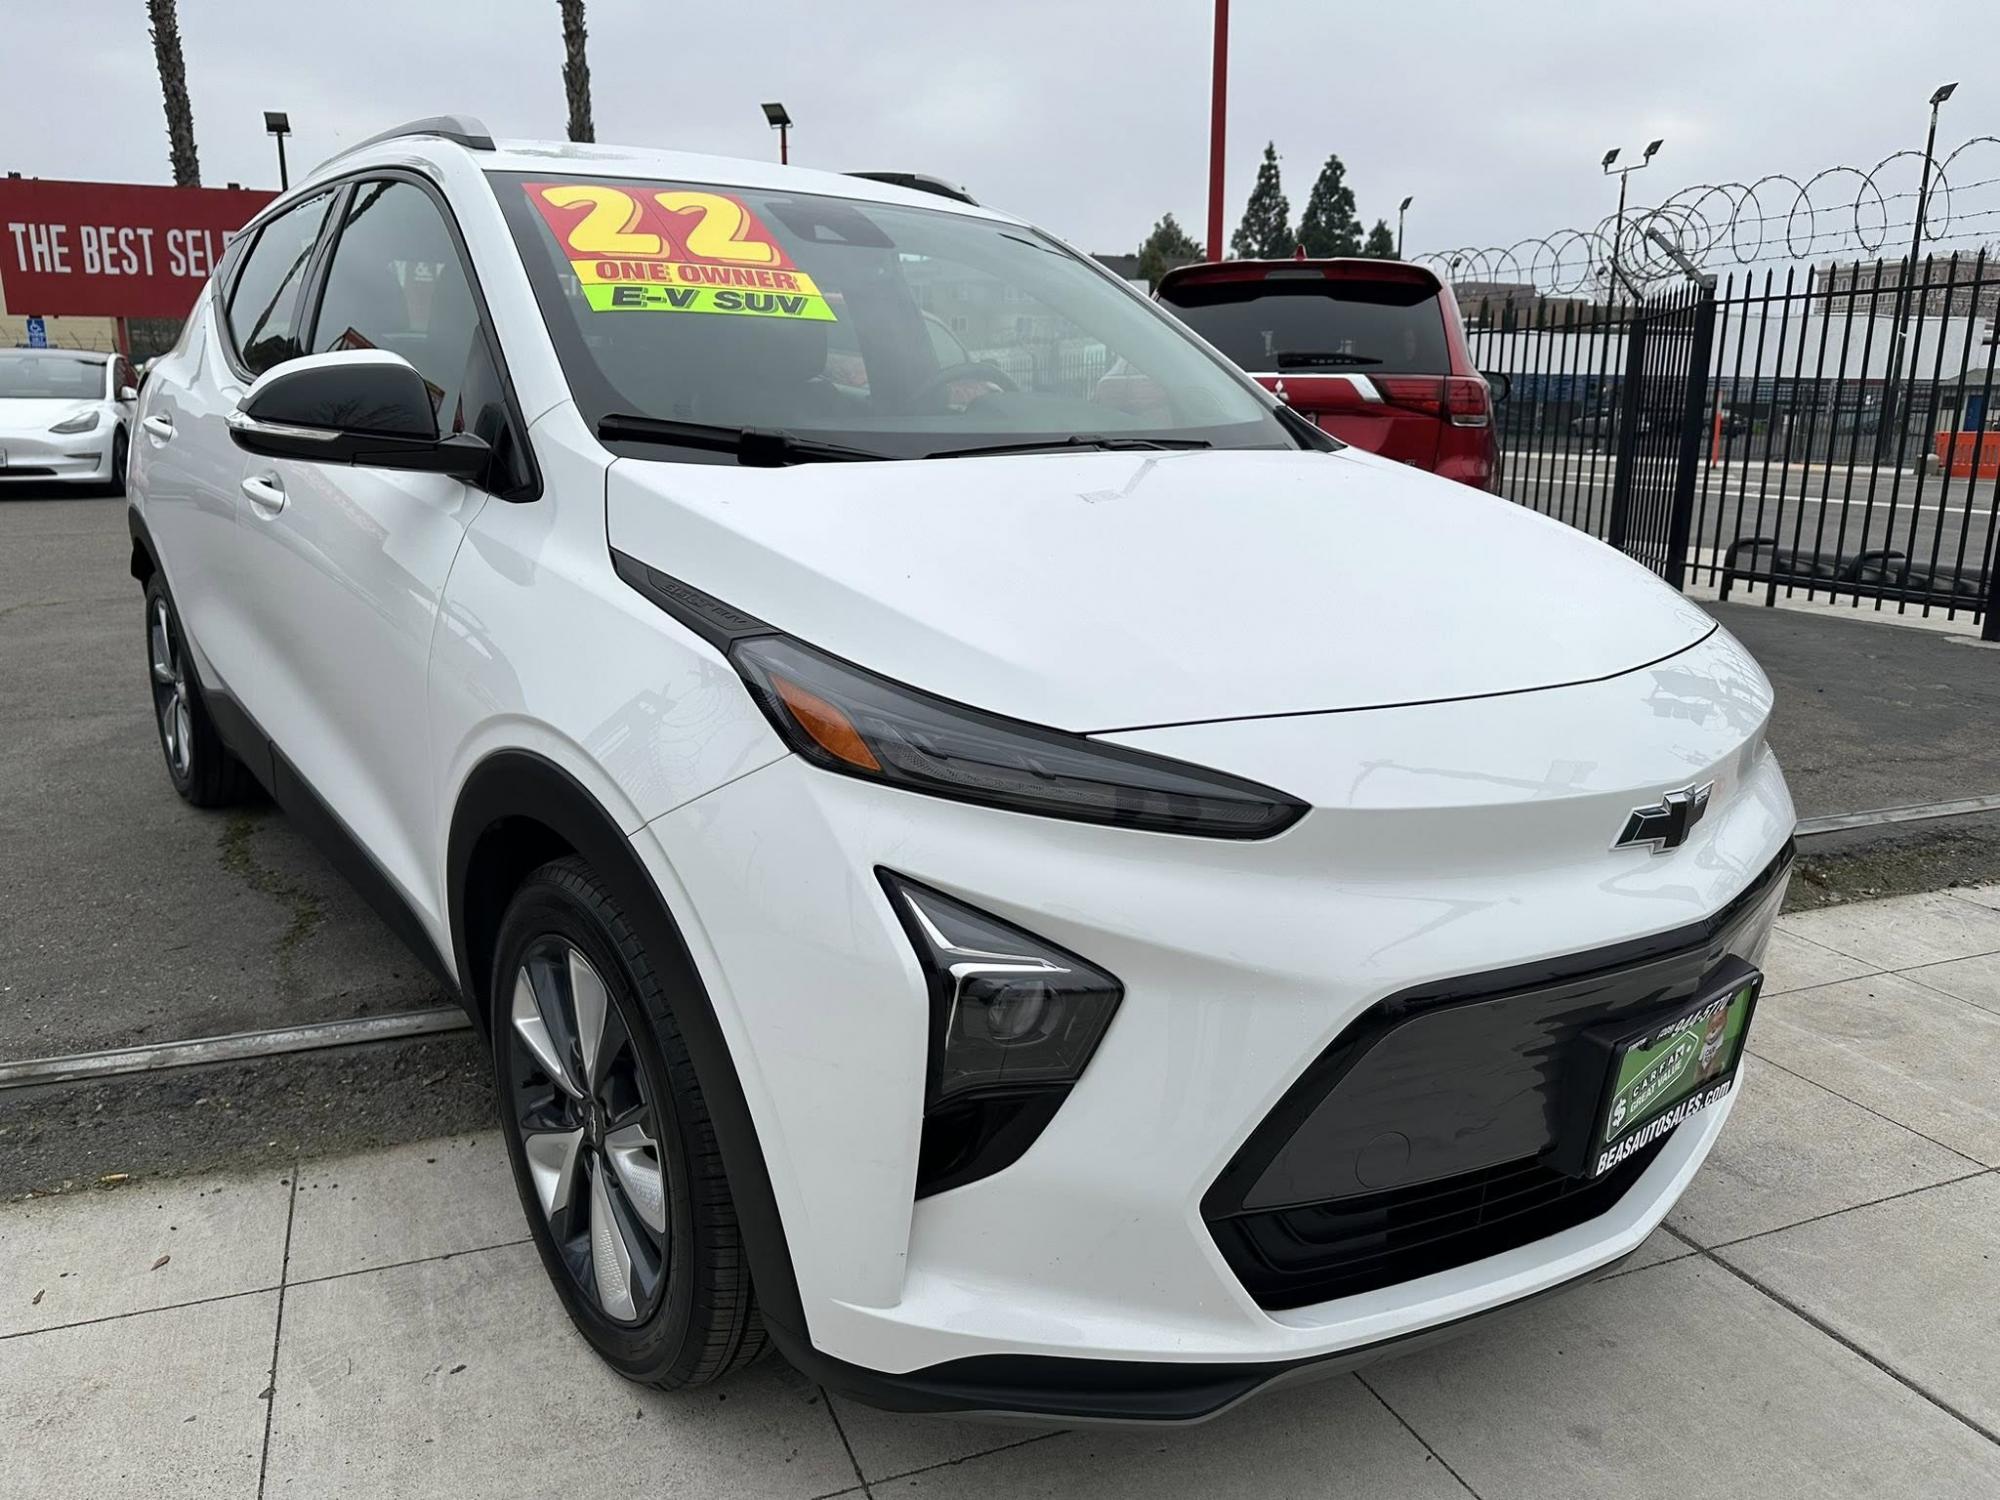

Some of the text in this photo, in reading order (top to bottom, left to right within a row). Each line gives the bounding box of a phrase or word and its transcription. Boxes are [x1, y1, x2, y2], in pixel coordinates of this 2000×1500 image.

[8, 222, 71, 273] THE
[80, 225, 153, 276] BEST
[595, 261, 800, 291] ONE OWNER
[612, 286, 808, 315] E-V SUV
[1630, 1083, 1656, 1112] GREAT
[1596, 1080, 1731, 1176] BEASAUTOSALES.com
